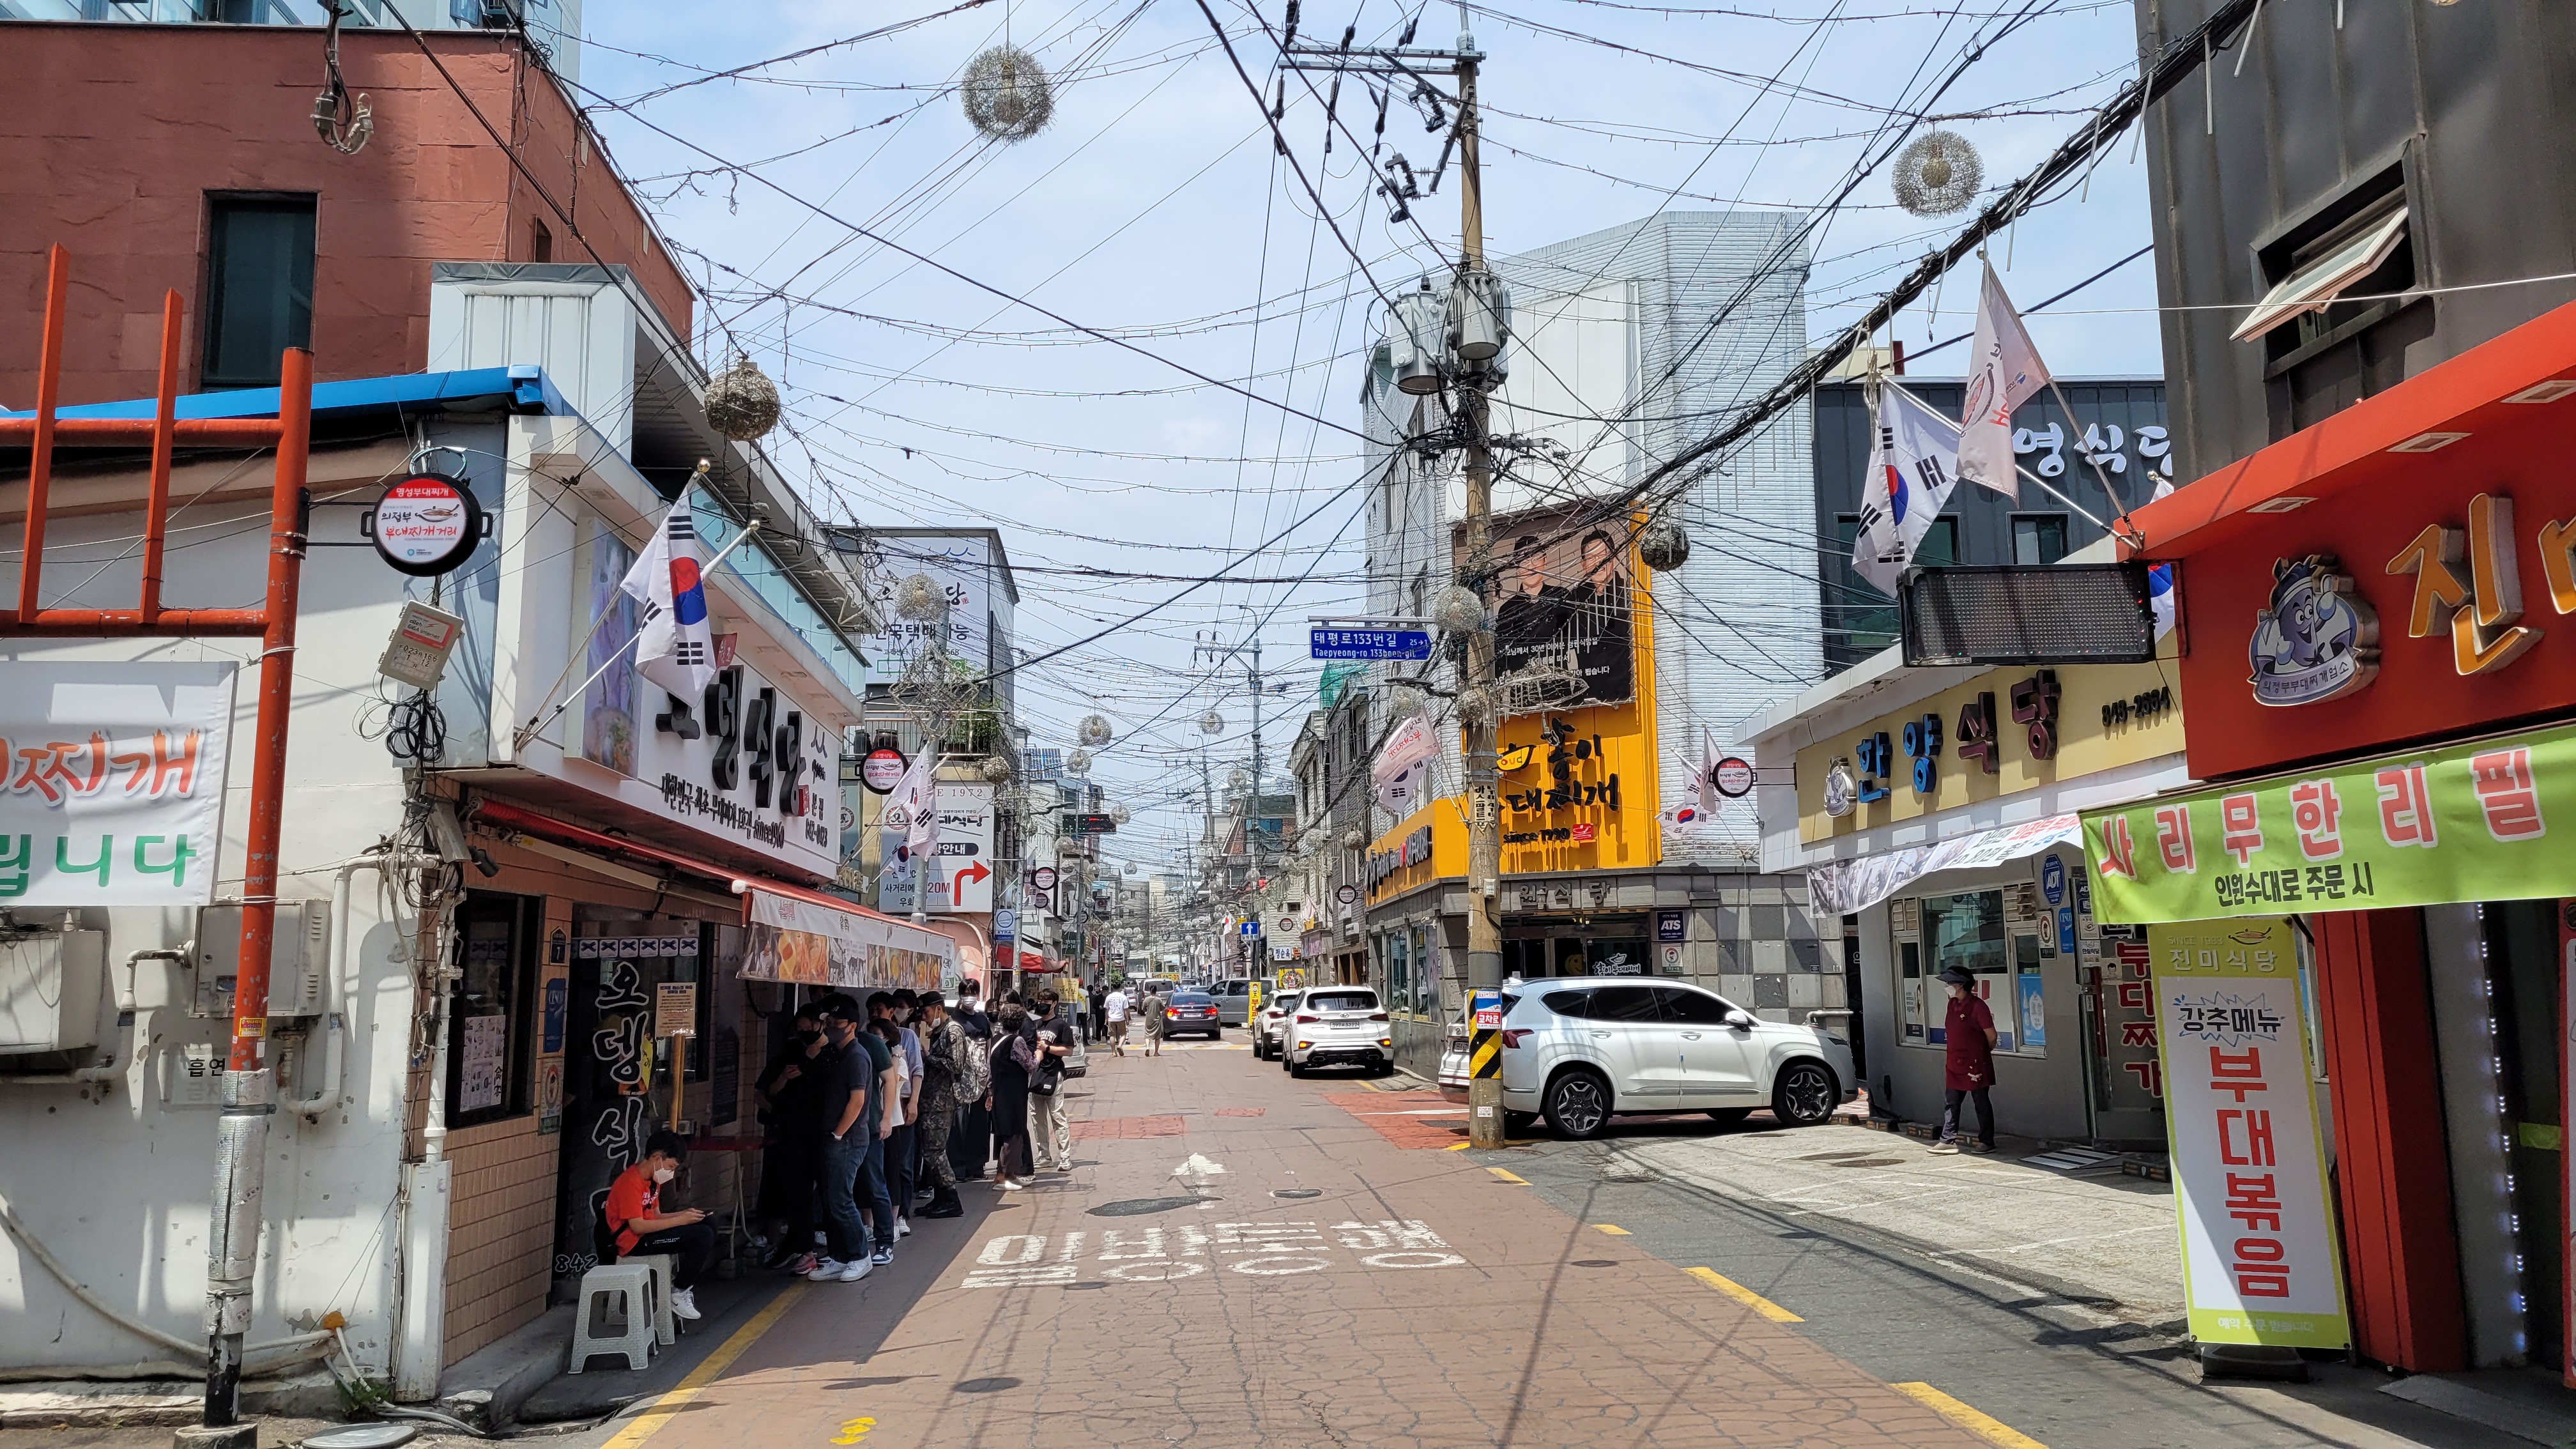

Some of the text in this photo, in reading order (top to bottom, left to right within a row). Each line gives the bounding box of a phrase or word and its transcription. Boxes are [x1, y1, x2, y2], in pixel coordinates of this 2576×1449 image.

[396, 487, 449, 497] 명성부대찌개
[381, 511, 411, 523] 의정부
[2386, 492, 2576, 675] 진
[1314, 632, 1397, 647] 태평로133번길
[1314, 648, 1368, 658] Taepyeong-ro
[1856, 669, 2062, 804] 한양식당
[0, 728, 200, 802] 찌개
[951, 788, 983, 797] 1972
[1499, 773, 1618, 811] 대찌개
[2046, 871, 2060, 890] ADT
[2215, 862, 2374, 907] 인원수대로 주문 시
[899, 897, 914, 906] 우회
[1660, 920, 1681, 930] ATS
[2168, 949, 2278, 972] 진미식당
[1478, 1013, 1499, 1024] 교차로
[2179, 1007, 2281, 1033] 강추메뉴
[188, 1058, 226, 1077] 흡연
[2209, 1046, 2290, 1298] 부대볶음
